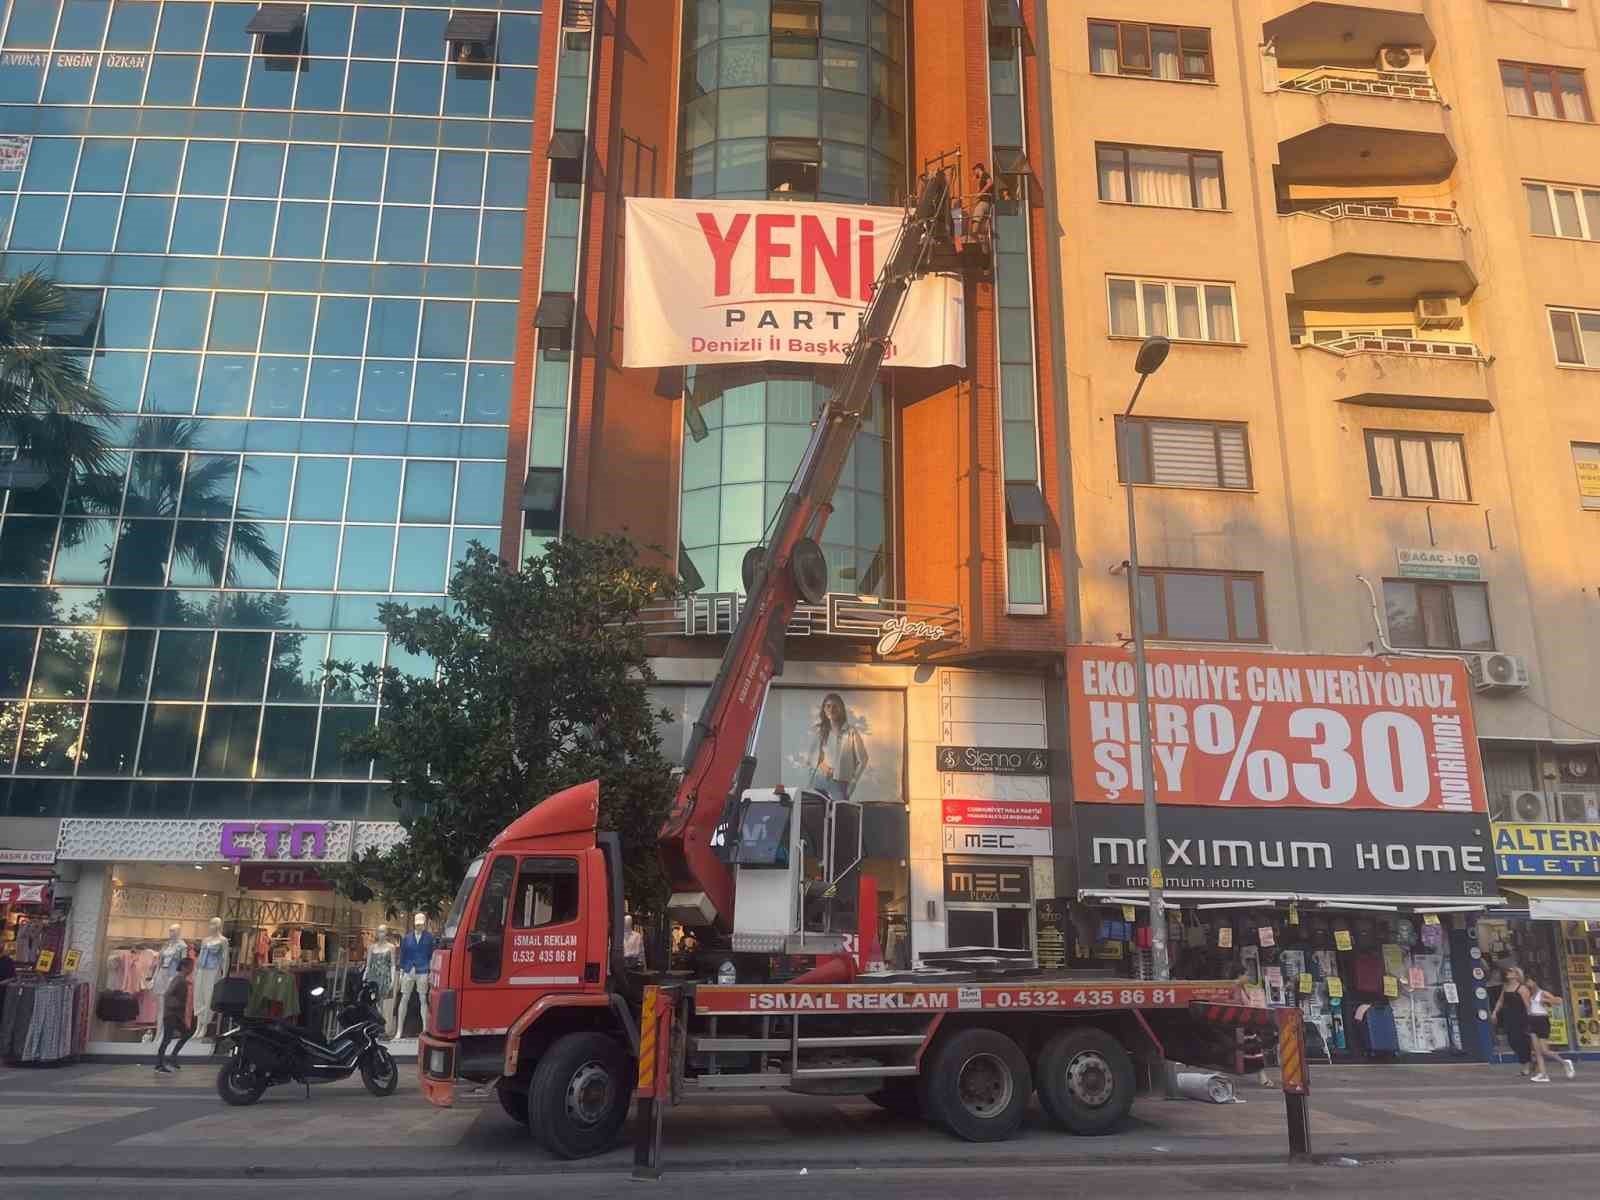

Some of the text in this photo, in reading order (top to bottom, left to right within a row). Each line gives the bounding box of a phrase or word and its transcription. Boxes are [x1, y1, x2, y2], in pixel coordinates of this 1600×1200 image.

[57, 53, 94, 68] ENGİN
[691, 337, 762, 353] Denizli
[788, 339, 897, 360] Başkağı
[1246, 667, 1301, 703] CAN
[1306, 665, 1456, 709] VERİYORUZ
[1194, 704, 1431, 808] %30
[1431, 714, 1473, 812] İNDİRİMDE
[1356, 843, 1486, 872] HOME
[544, 936, 577, 946] REKLAM
[513, 951, 535, 962] 0.532
[539, 951, 554, 962] 435
[846, 992, 948, 1009] REKLAM
[1073, 990, 1113, 1005] 435
[1120, 989, 1145, 1004] 86
[1152, 989, 1176, 1004] 81
